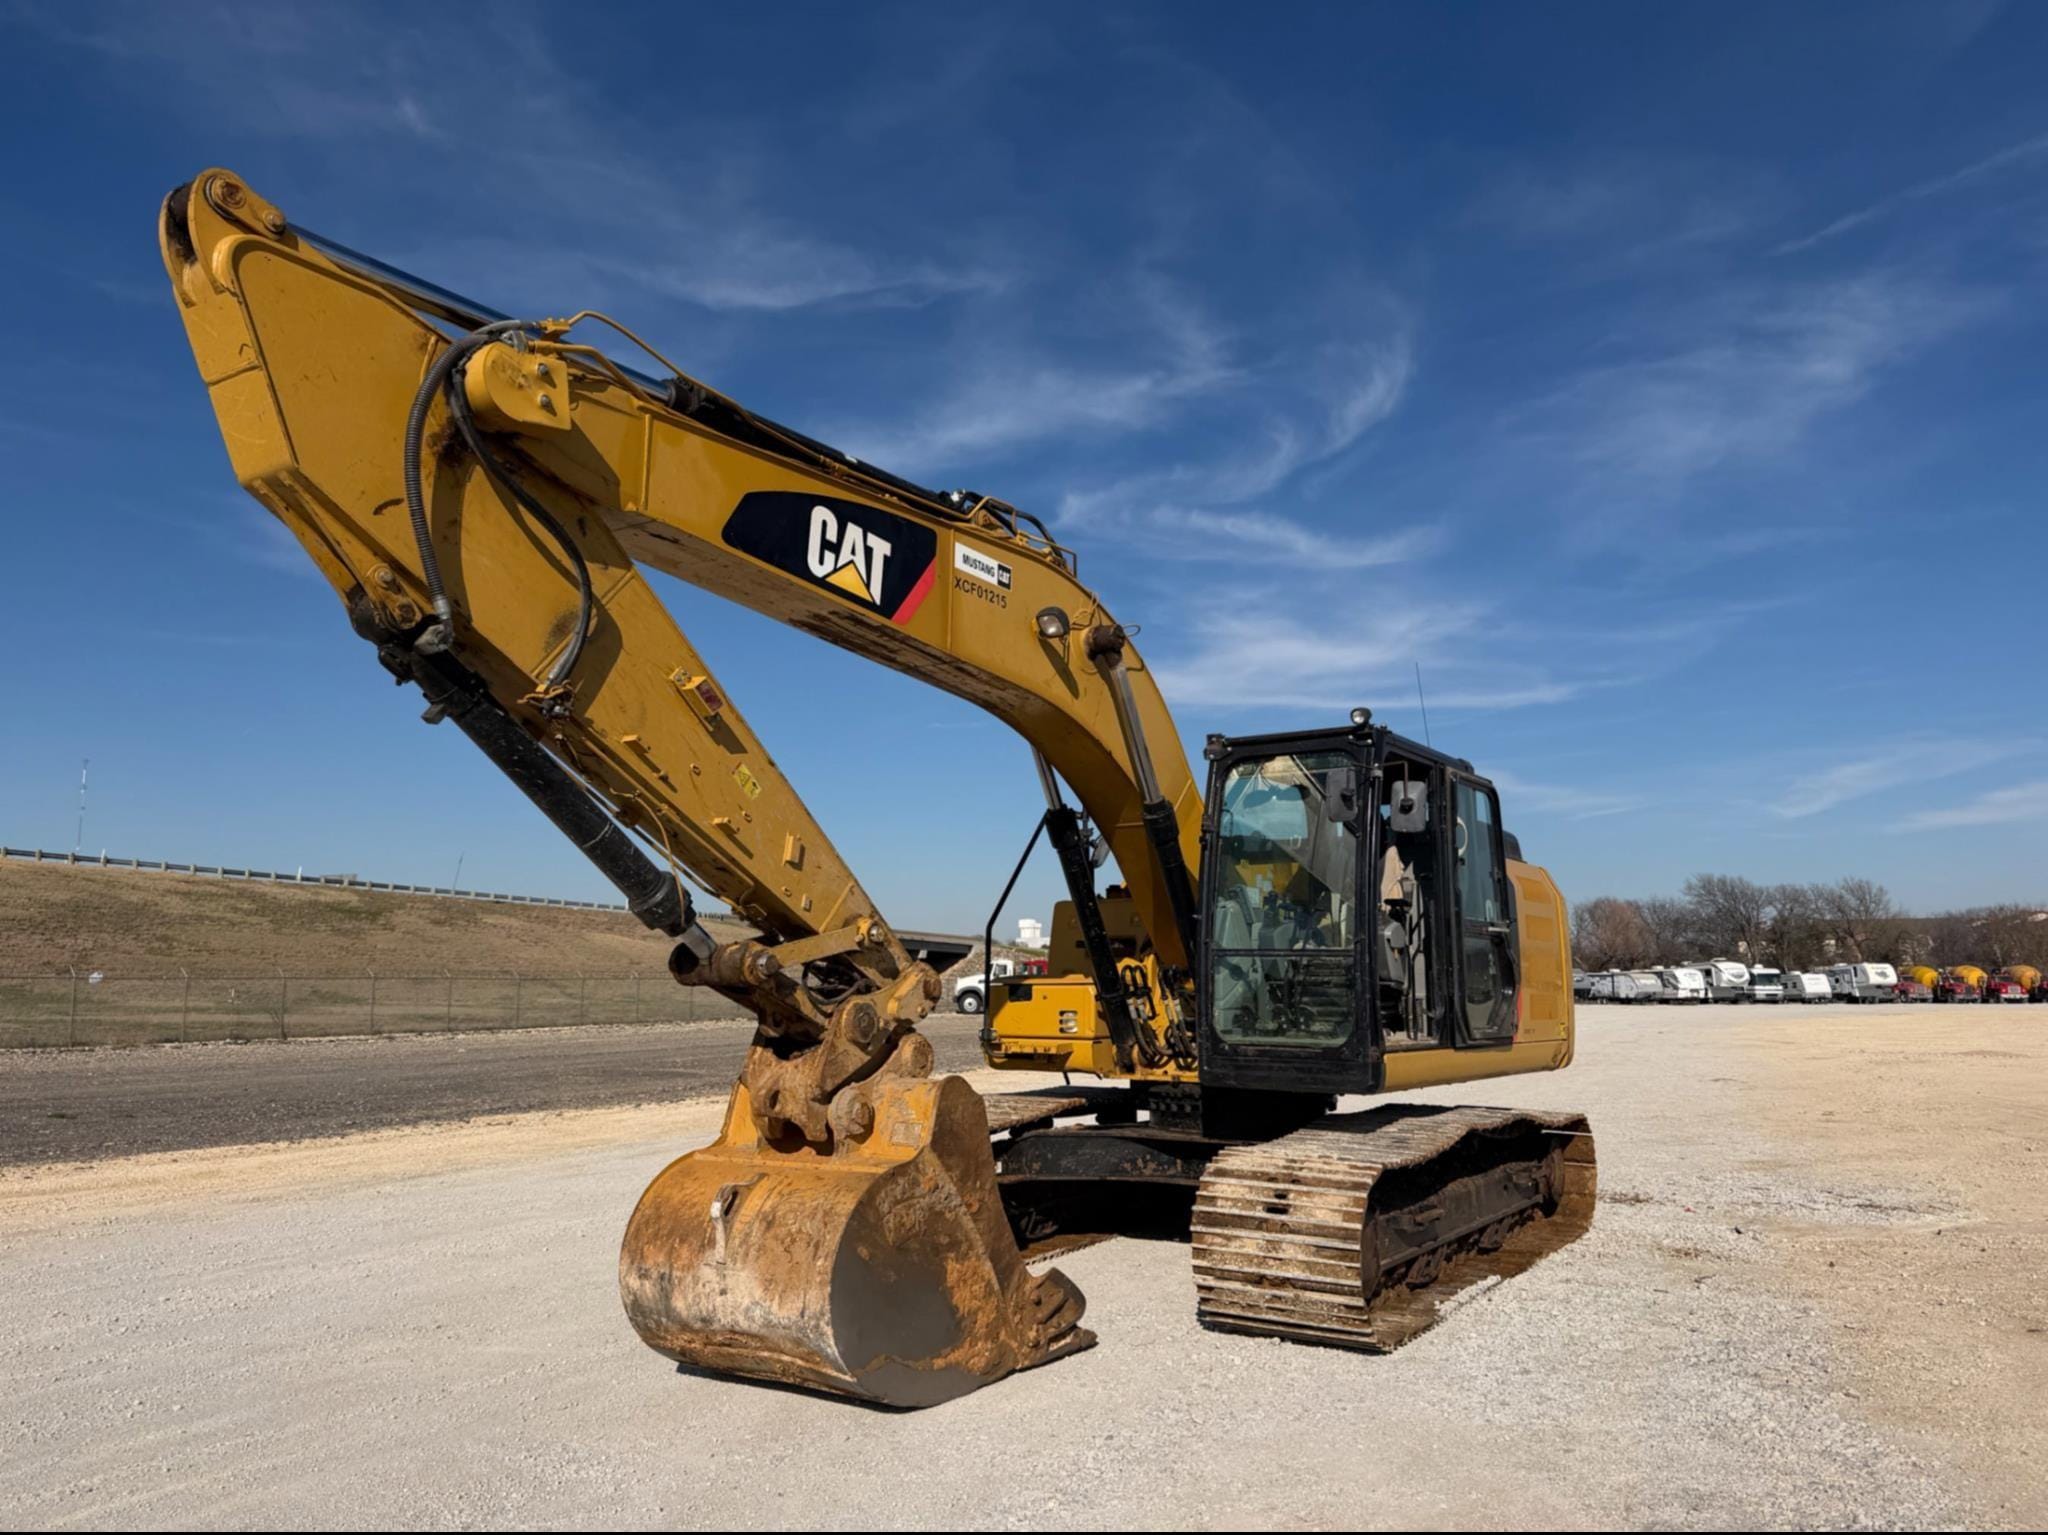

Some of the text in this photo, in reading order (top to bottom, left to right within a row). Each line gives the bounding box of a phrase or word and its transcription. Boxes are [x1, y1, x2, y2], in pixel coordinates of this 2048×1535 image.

[807, 505, 892, 606] CAT
[962, 553, 995, 577] MUSTANG
[954, 576, 1007, 609] XCF01215
